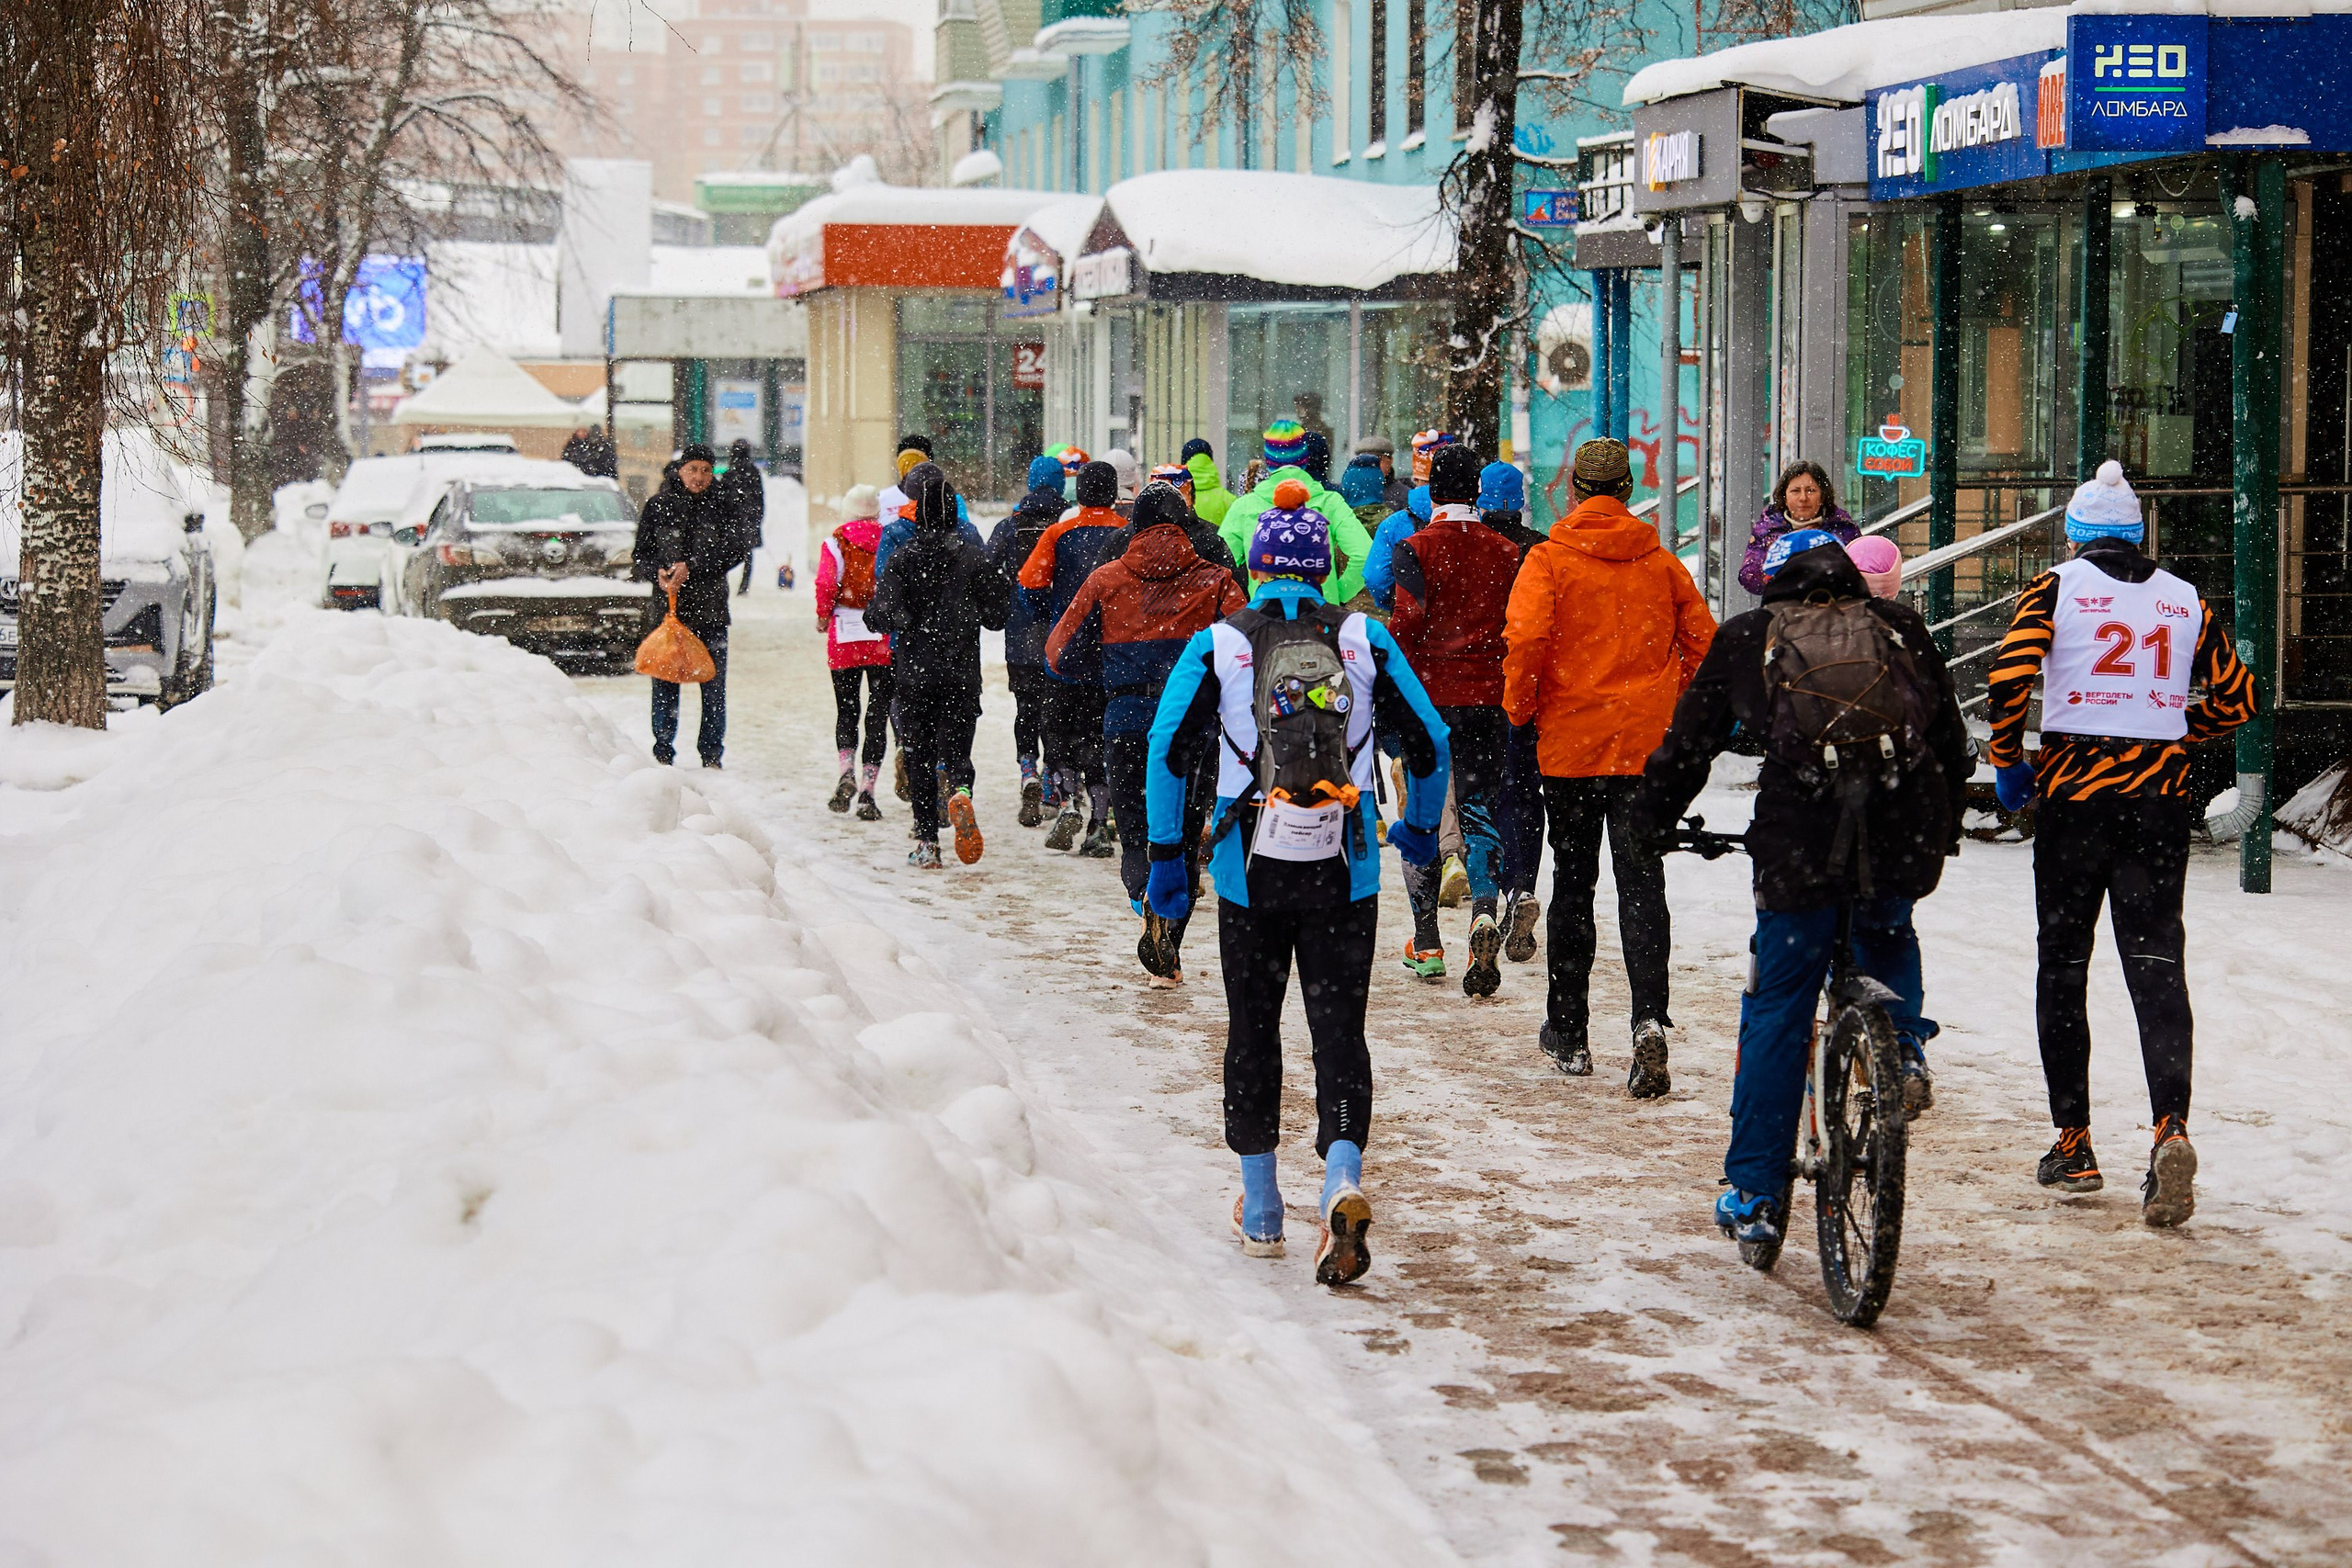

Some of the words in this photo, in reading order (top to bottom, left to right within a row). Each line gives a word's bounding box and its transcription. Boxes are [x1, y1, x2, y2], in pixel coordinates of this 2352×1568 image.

[2091, 100, 2188, 117] ЛОМБАРД
[1929, 96, 2013, 153] ЛОМБАРД
[1865, 457, 1914, 471] СОБОЙ
[2091, 621, 2172, 680] 21
[2086, 692, 2133, 700] ВЕРТОЛЕТЫ
